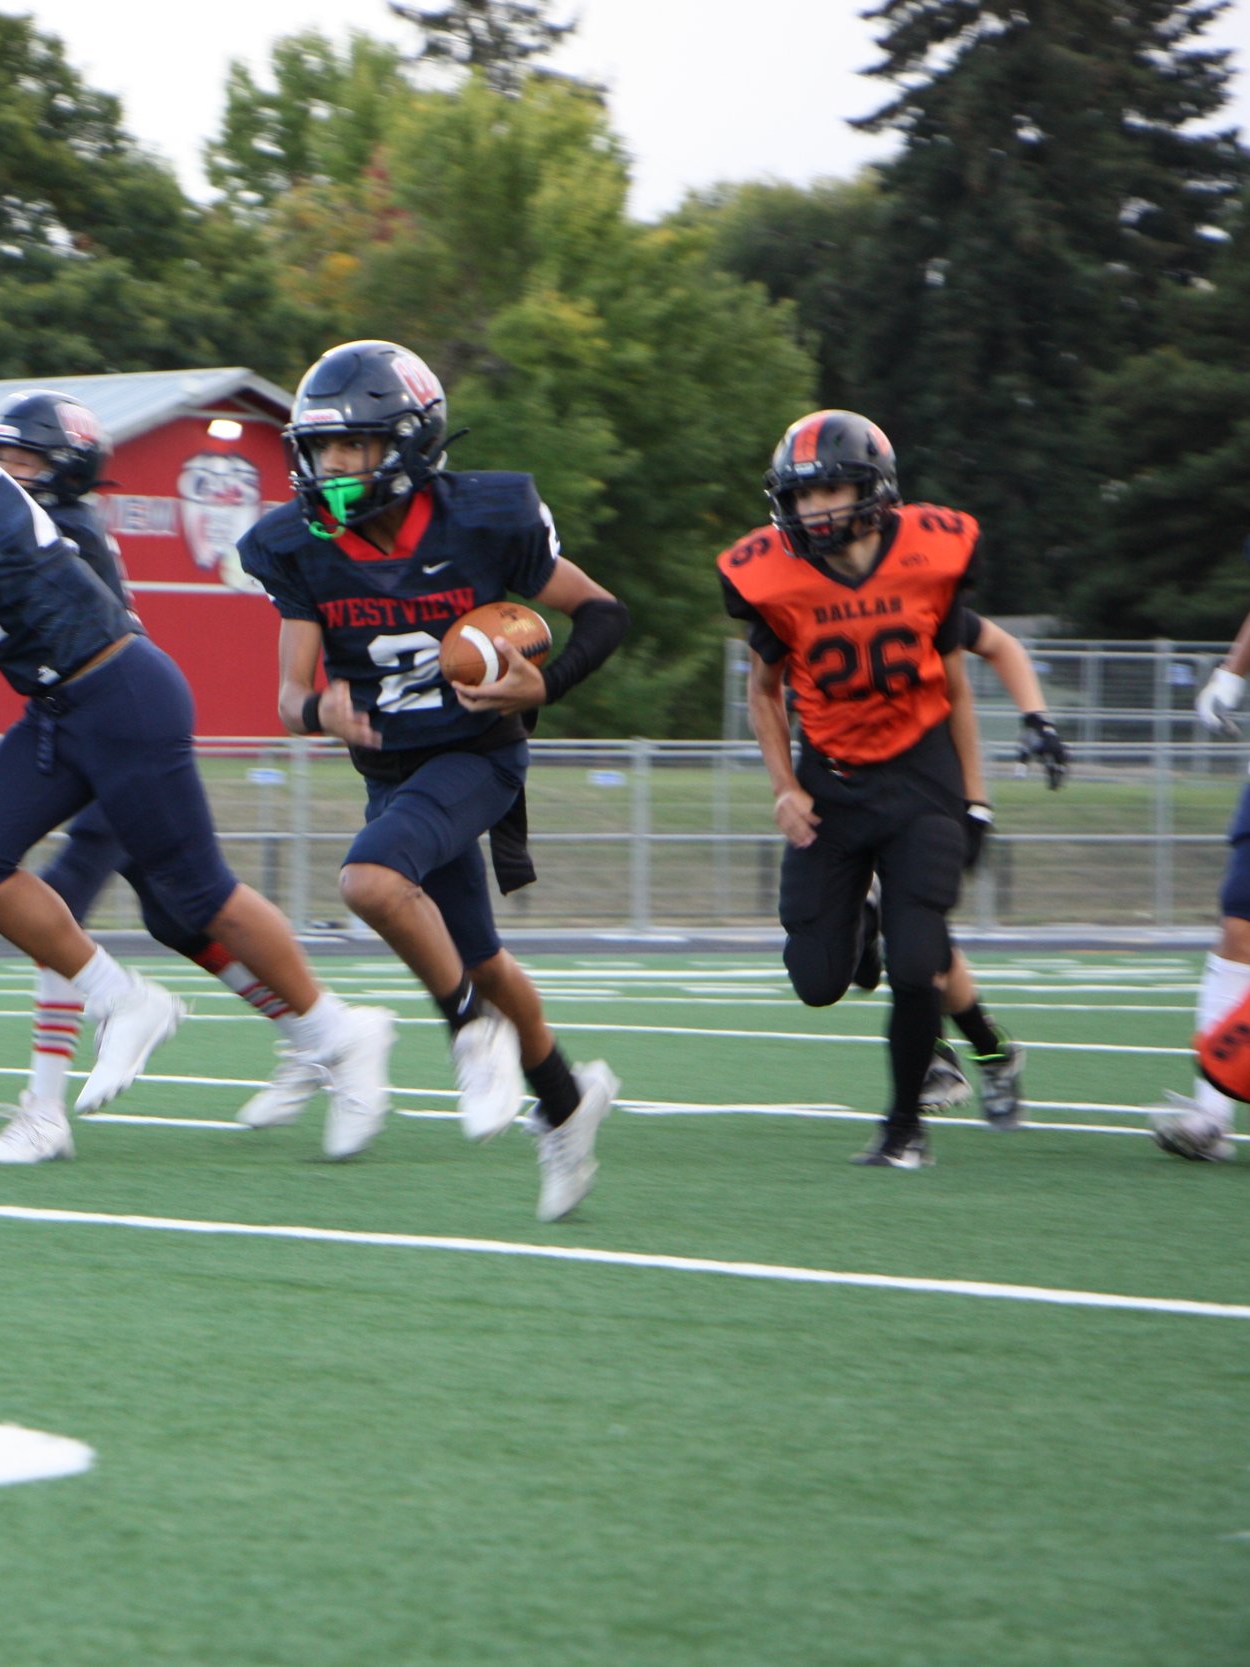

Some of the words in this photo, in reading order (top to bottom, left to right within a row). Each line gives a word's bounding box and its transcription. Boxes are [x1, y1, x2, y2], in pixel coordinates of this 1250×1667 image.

[318, 587, 476, 629] WESTVIEW
[813, 596, 904, 625] DALLAS
[367, 631, 443, 714] 2
[807, 626, 923, 700] 26
